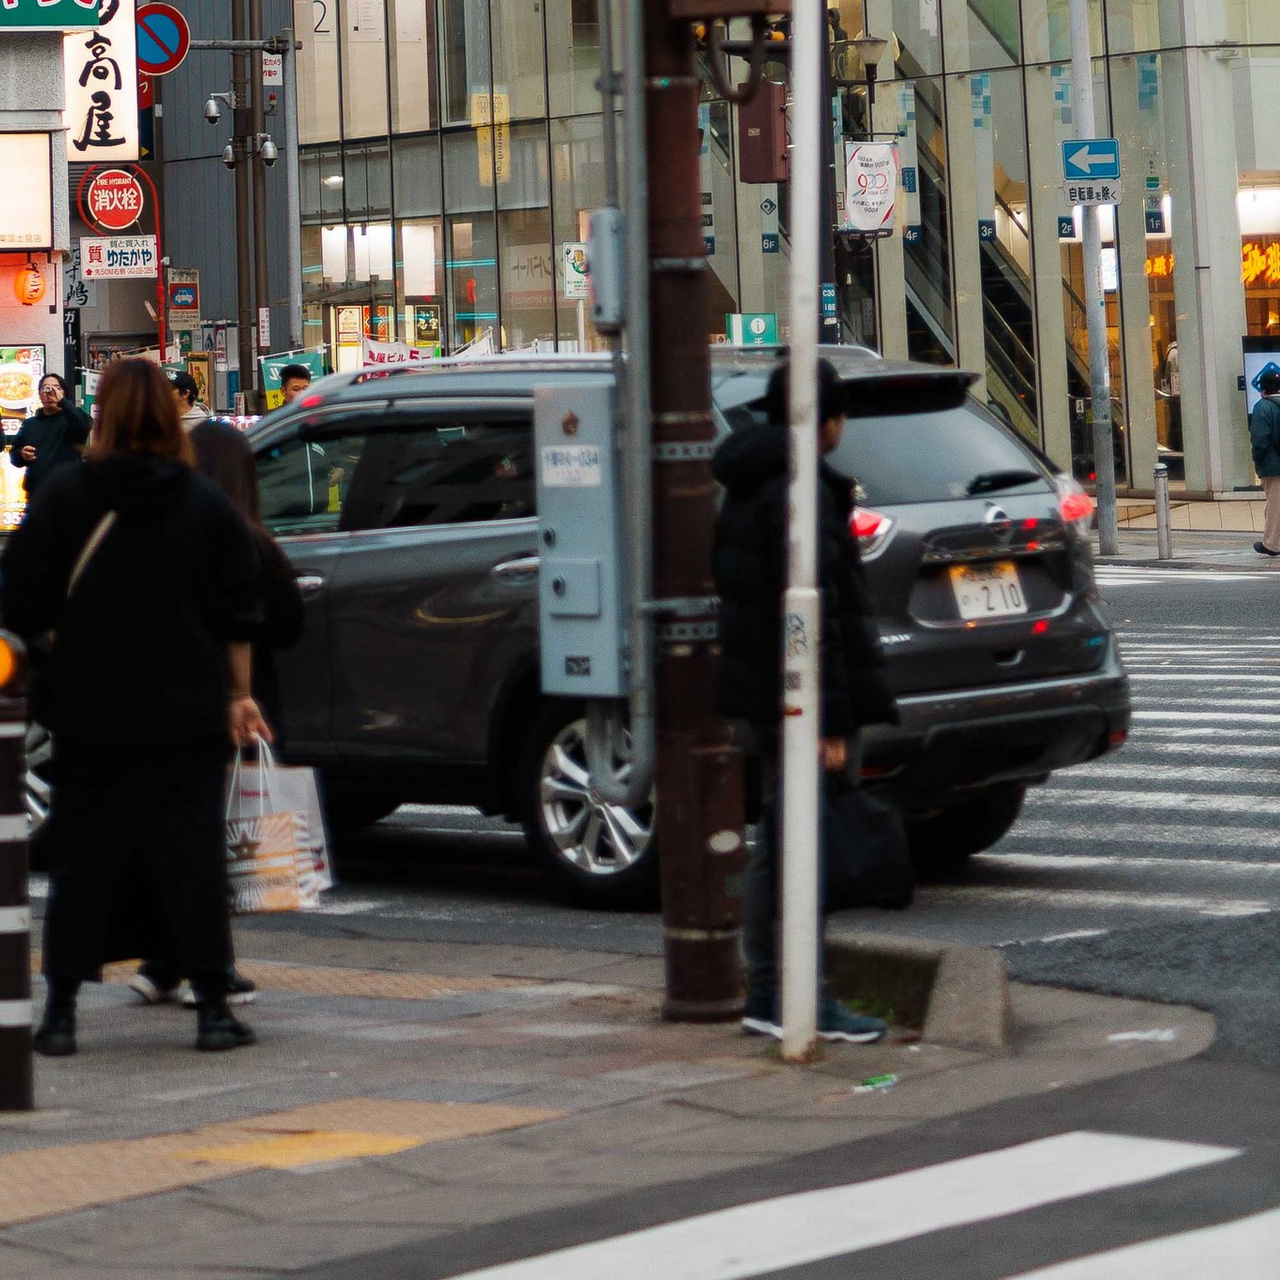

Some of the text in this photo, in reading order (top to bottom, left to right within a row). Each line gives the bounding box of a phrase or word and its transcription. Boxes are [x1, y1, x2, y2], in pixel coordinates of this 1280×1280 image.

[312, 0, 330, 34] 2
[93, 187, 138, 211] 消火栓
[1068, 185, 1118, 203] 自転車を除く
[1061, 222, 1073, 234] 2F
[1149, 218, 1161, 229] 1F
[905, 230, 918, 241] 4F
[981, 226, 993, 237] 3F
[763, 239, 776, 249] 6F
[88, 245, 103, 264] 質
[107, 249, 152, 267] ゆたかや
